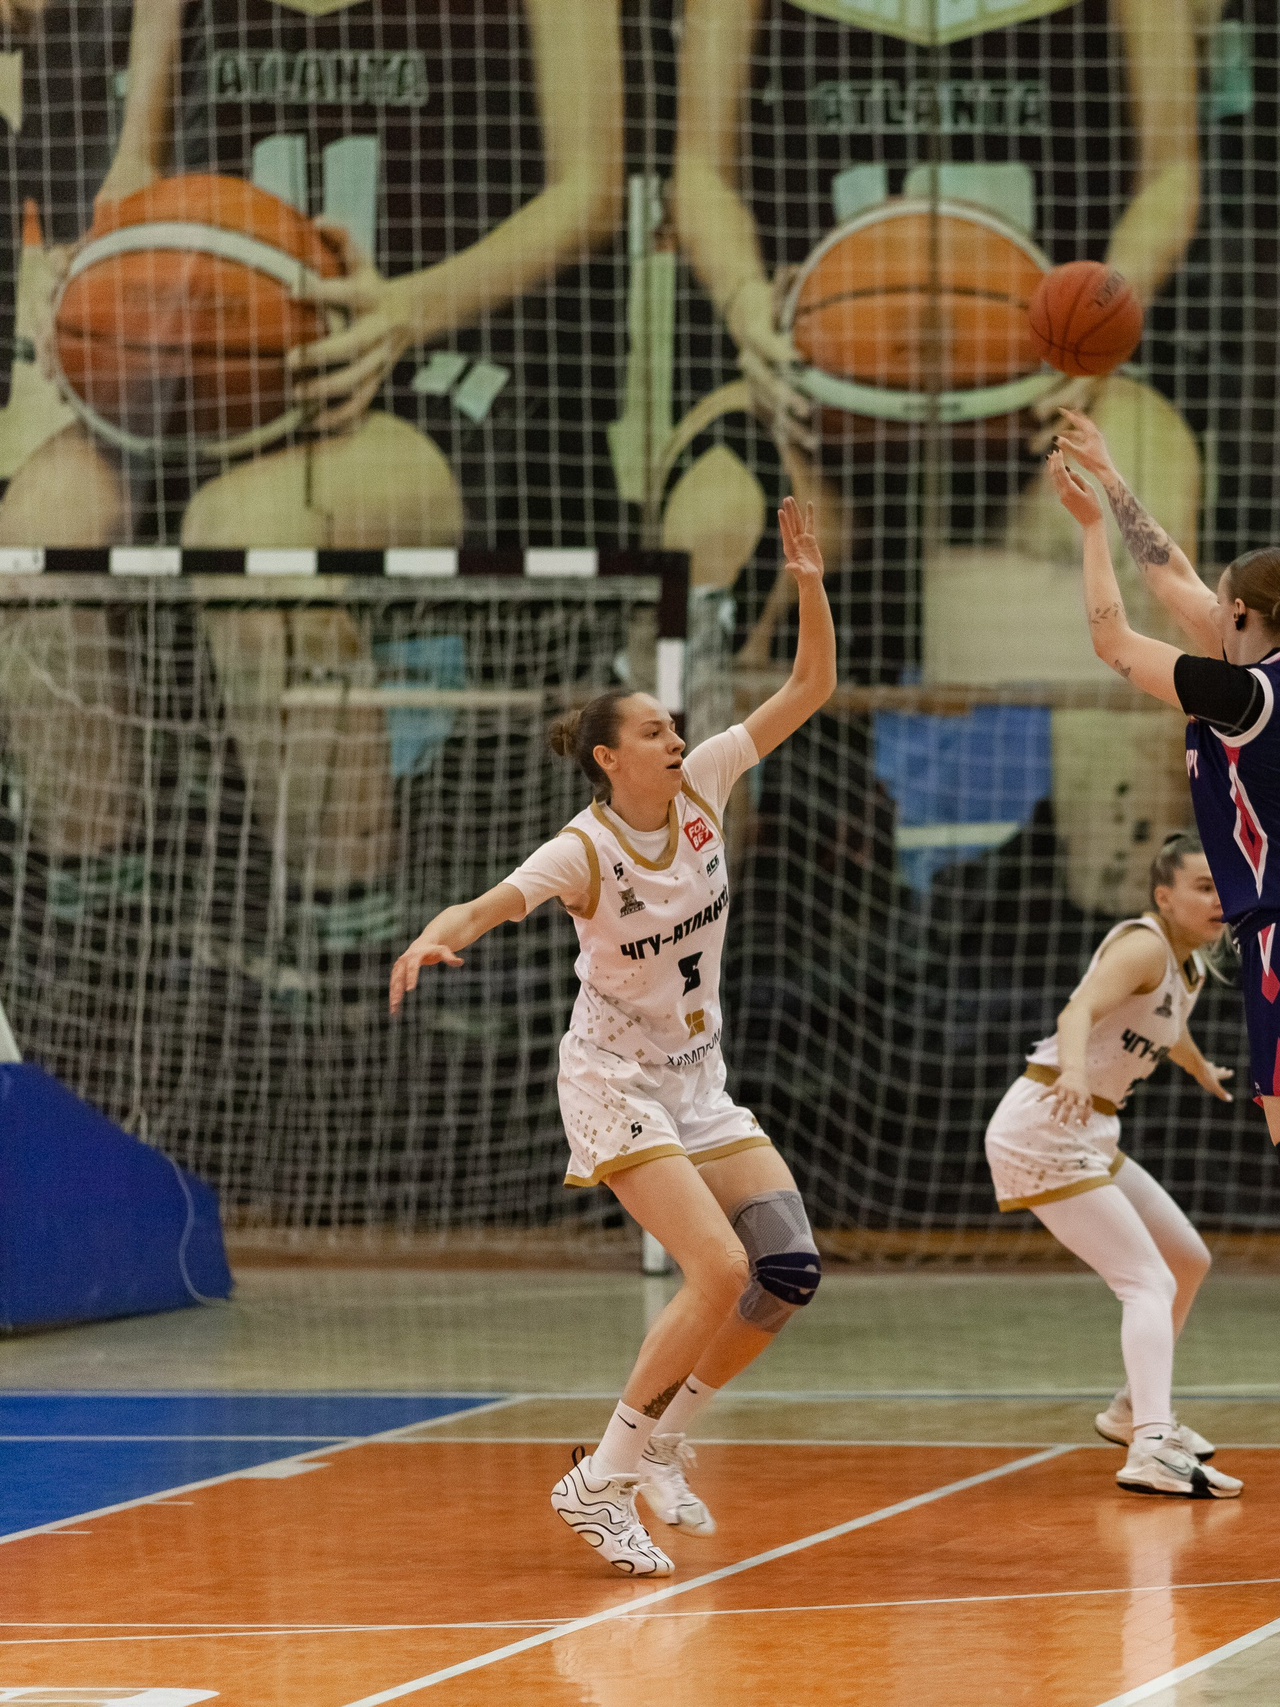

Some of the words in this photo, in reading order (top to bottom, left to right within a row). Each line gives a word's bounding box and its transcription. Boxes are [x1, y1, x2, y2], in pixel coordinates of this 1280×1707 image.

[613, 862, 624, 881] 5
[677, 951, 704, 997] 5
[630, 1121, 643, 1139] 5
